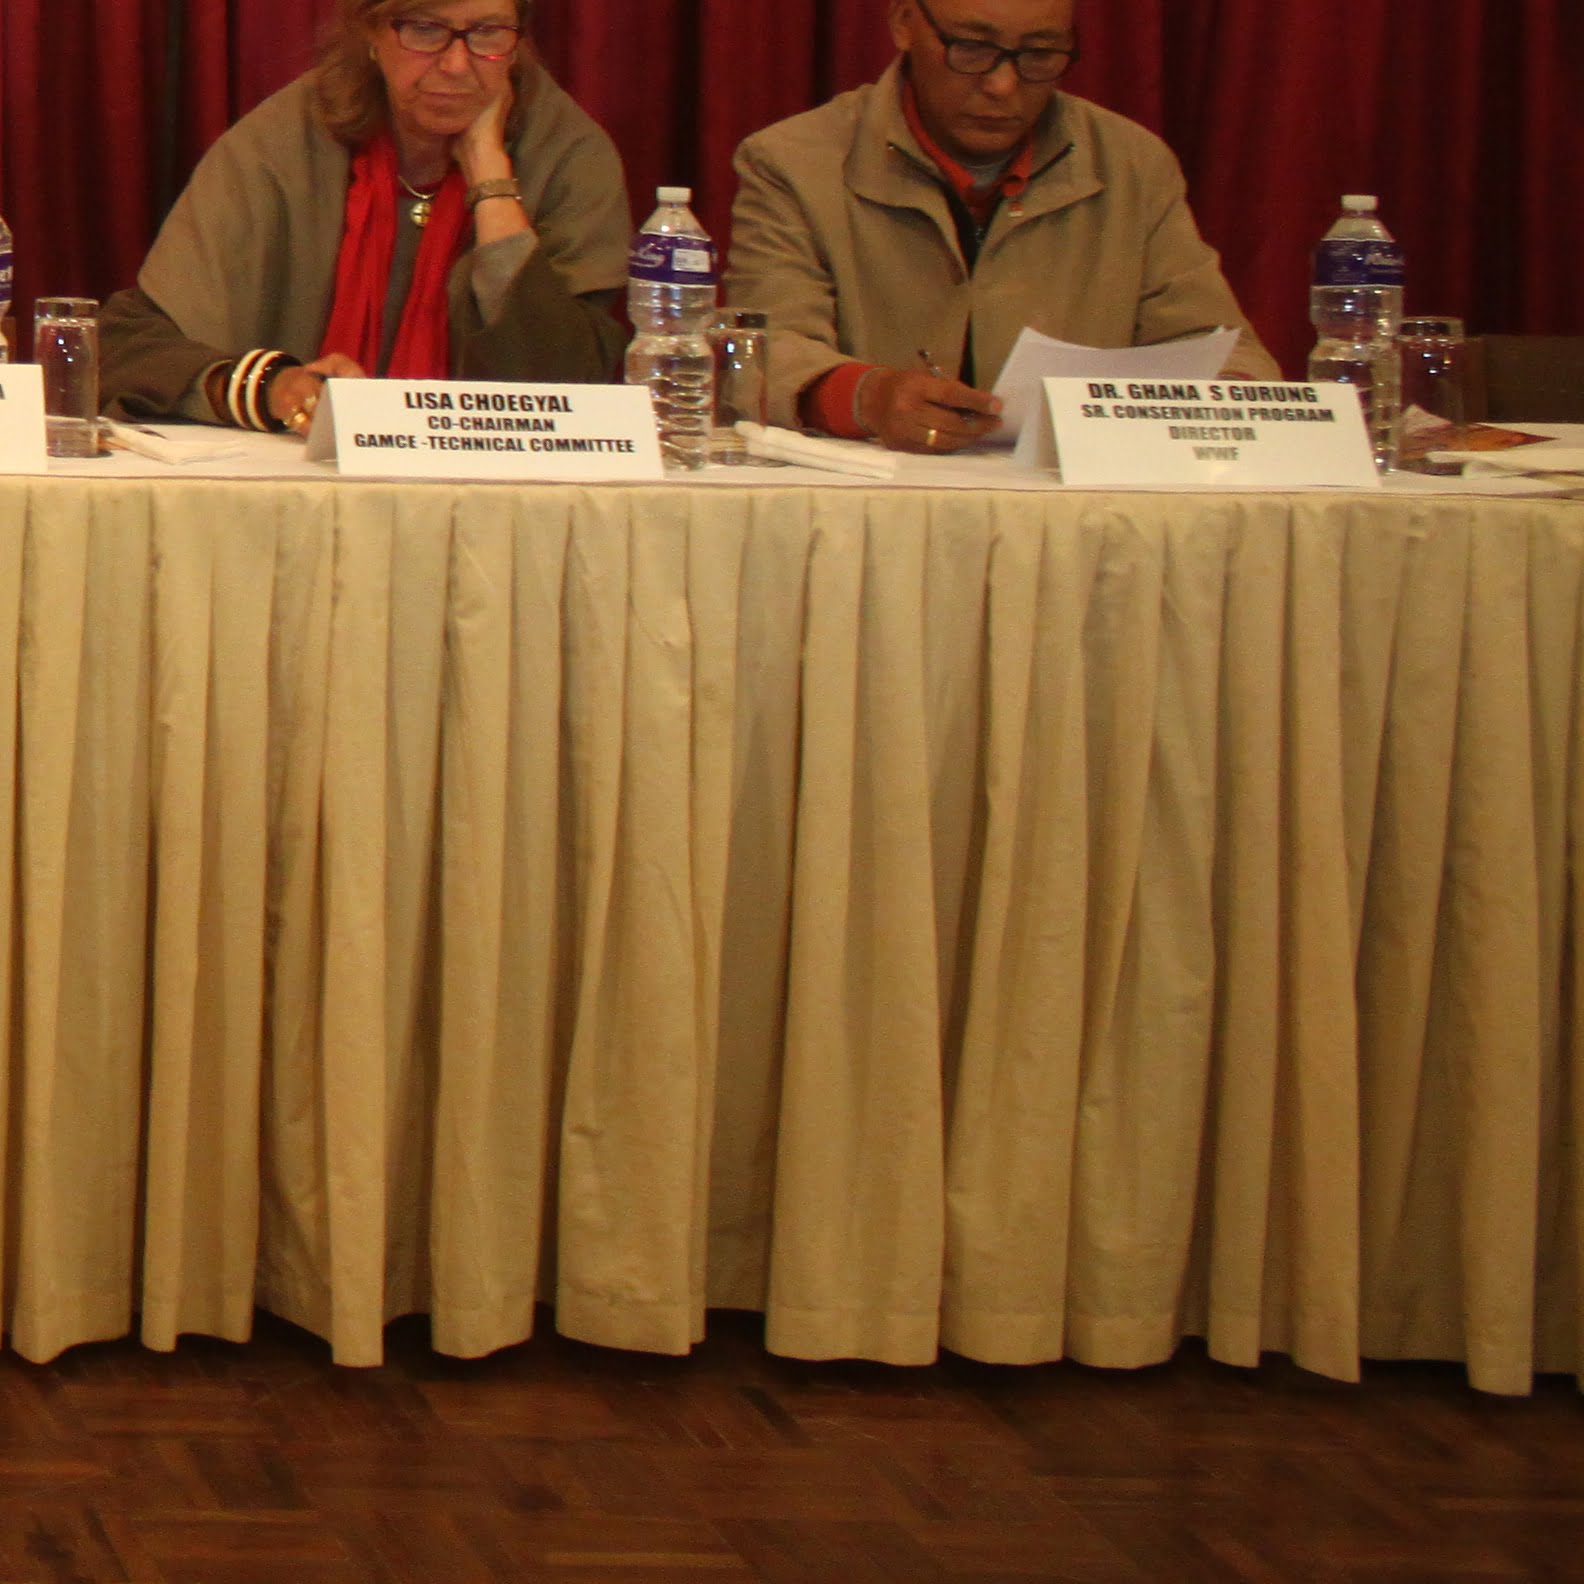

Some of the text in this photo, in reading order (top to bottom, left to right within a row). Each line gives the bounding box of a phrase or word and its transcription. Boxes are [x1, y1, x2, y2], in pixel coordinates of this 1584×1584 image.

[1088, 383, 1317, 402] DR. GHANA S GURUNG
[405, 392, 572, 412] LISA CHOEGYAL
[1113, 405, 1244, 421] CONSERVATION
[1248, 408, 1335, 422] PROGRAM
[428, 416, 554, 432] CO-CHAIRMAN
[1169, 426, 1256, 440] DIRECTOR
[354, 434, 416, 448] GAMCE
[531, 438, 635, 452] COMMITTEE
